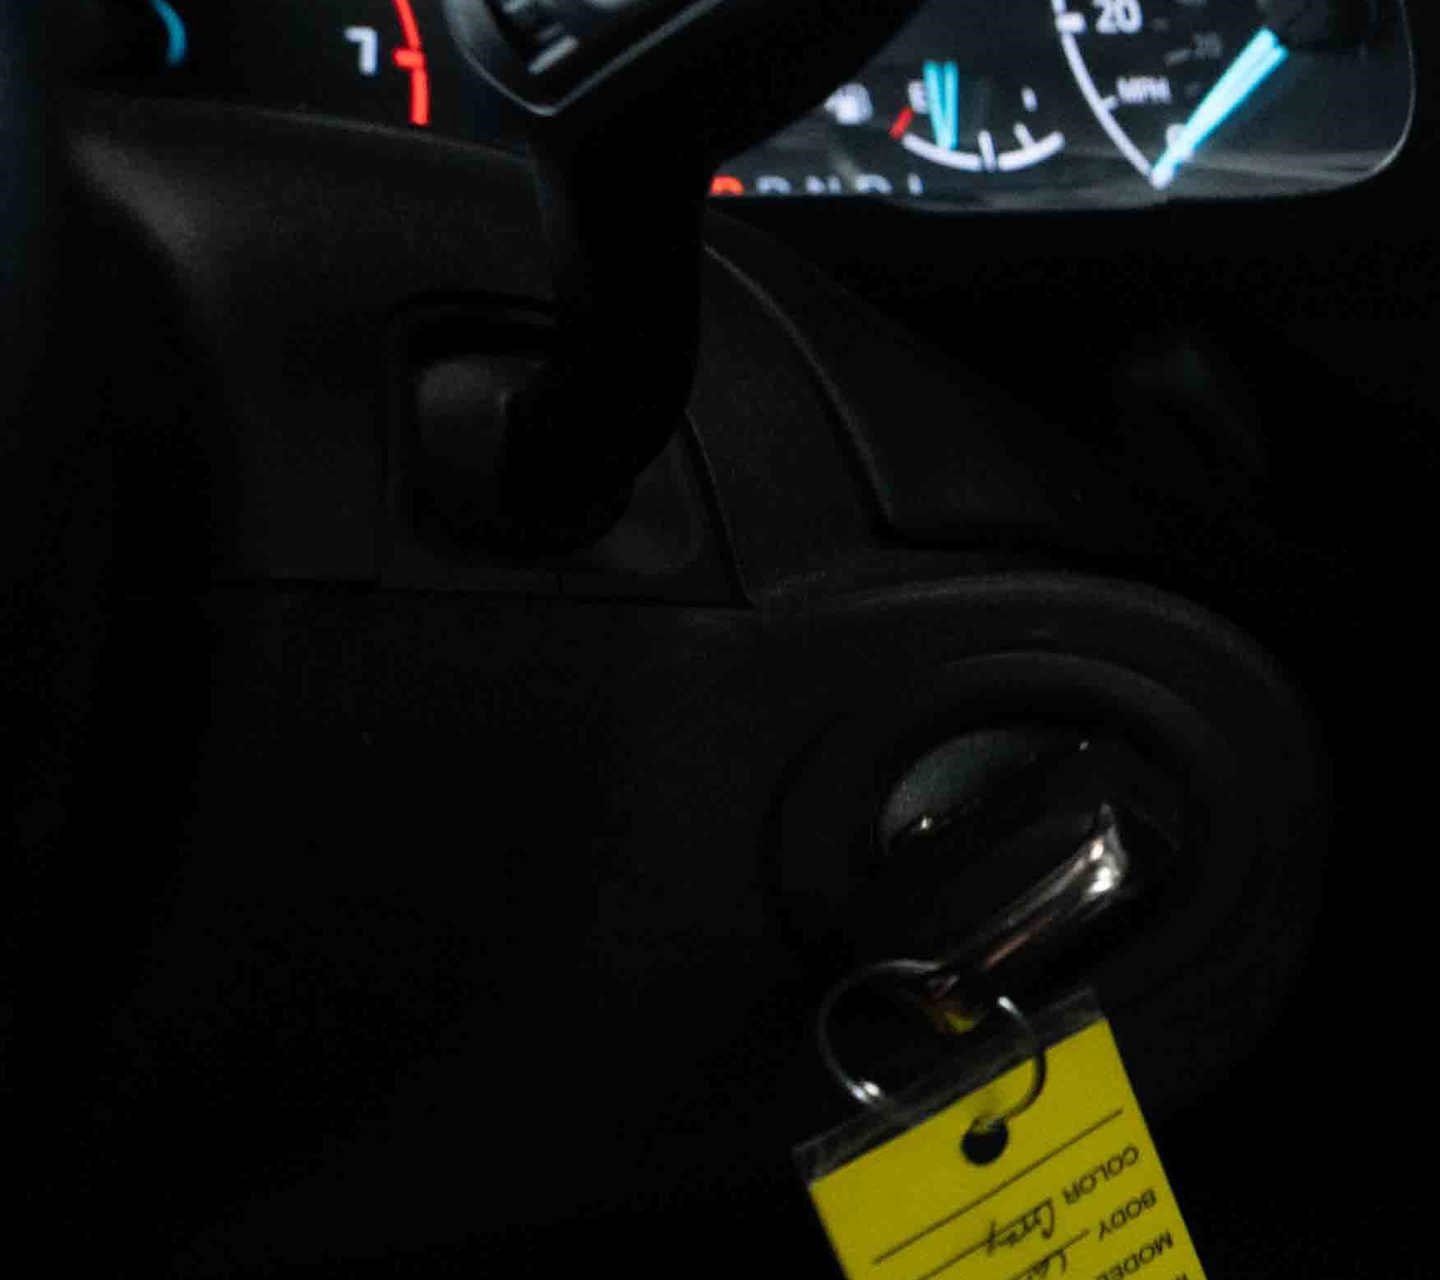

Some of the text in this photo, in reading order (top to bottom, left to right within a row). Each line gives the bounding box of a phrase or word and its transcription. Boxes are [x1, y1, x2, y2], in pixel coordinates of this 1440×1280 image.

[347, 28, 377, 73] 7
[1116, 76, 1173, 104] MPH
[1063, 1144, 1143, 1205] COLOR
[1099, 1187, 1159, 1241] BODY
